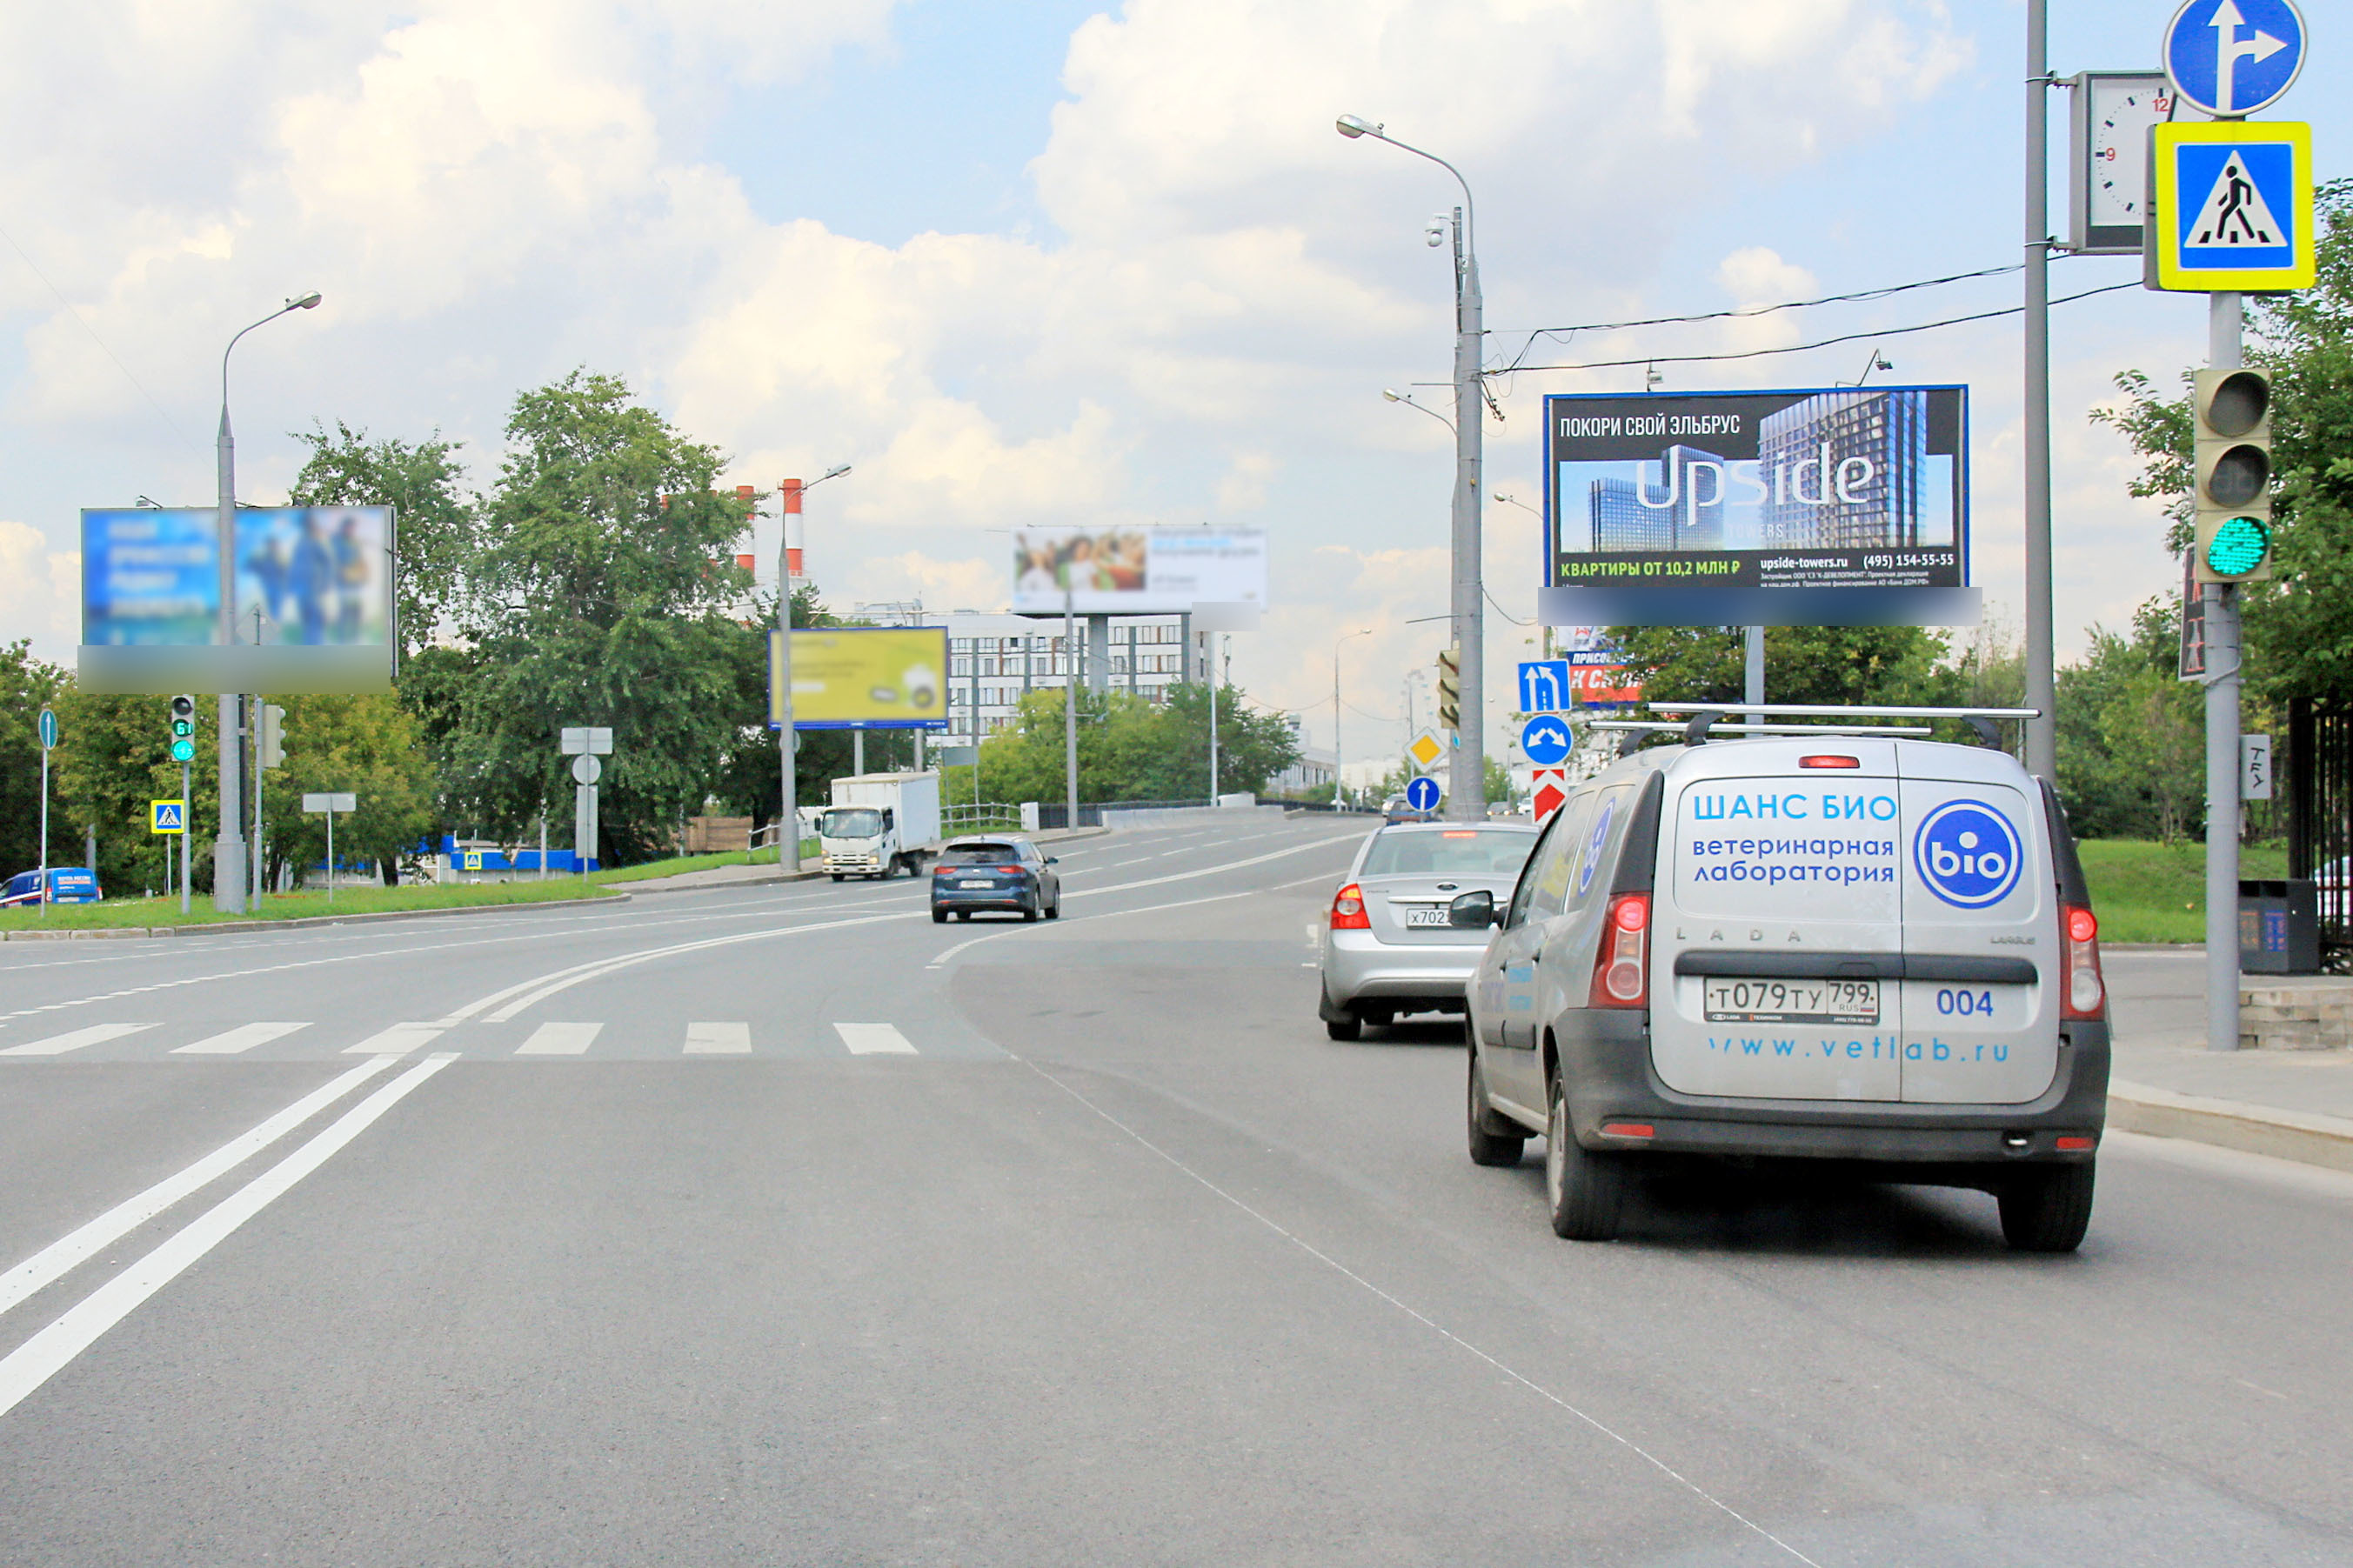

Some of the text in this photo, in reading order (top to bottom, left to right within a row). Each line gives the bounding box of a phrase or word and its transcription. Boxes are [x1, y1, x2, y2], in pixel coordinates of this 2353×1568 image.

[2152, 99, 2169, 112] 12
[2105, 148, 2116, 161] 9
[1560, 412, 1740, 437] ПОКОРИ СВОЙ ЭЛЬБРУС
[1561, 562, 1640, 577] КВАРТИРЫ
[1643, 562, 1662, 576] ОТ
[1666, 561, 1692, 577] 10,2
[1696, 561, 1728, 574] МЛН
[1761, 557, 1848, 570] upside-towers.ru
[1863, 554, 1954, 569] (495) 154-55-55
[177, 722, 192, 735] 61
[1694, 794, 1896, 821] ШАНС БИО
[1693, 838, 1894, 859] ветеринарная
[1931, 831, 2006, 879] bio
[1694, 860, 1894, 886] лаборатория
[1676, 926, 1801, 942] LADA
[1715, 983, 1869, 1009] Т079ТУ 799
[1936, 990, 1994, 1016] 004
[1839, 1004, 1859, 1012] RUS
